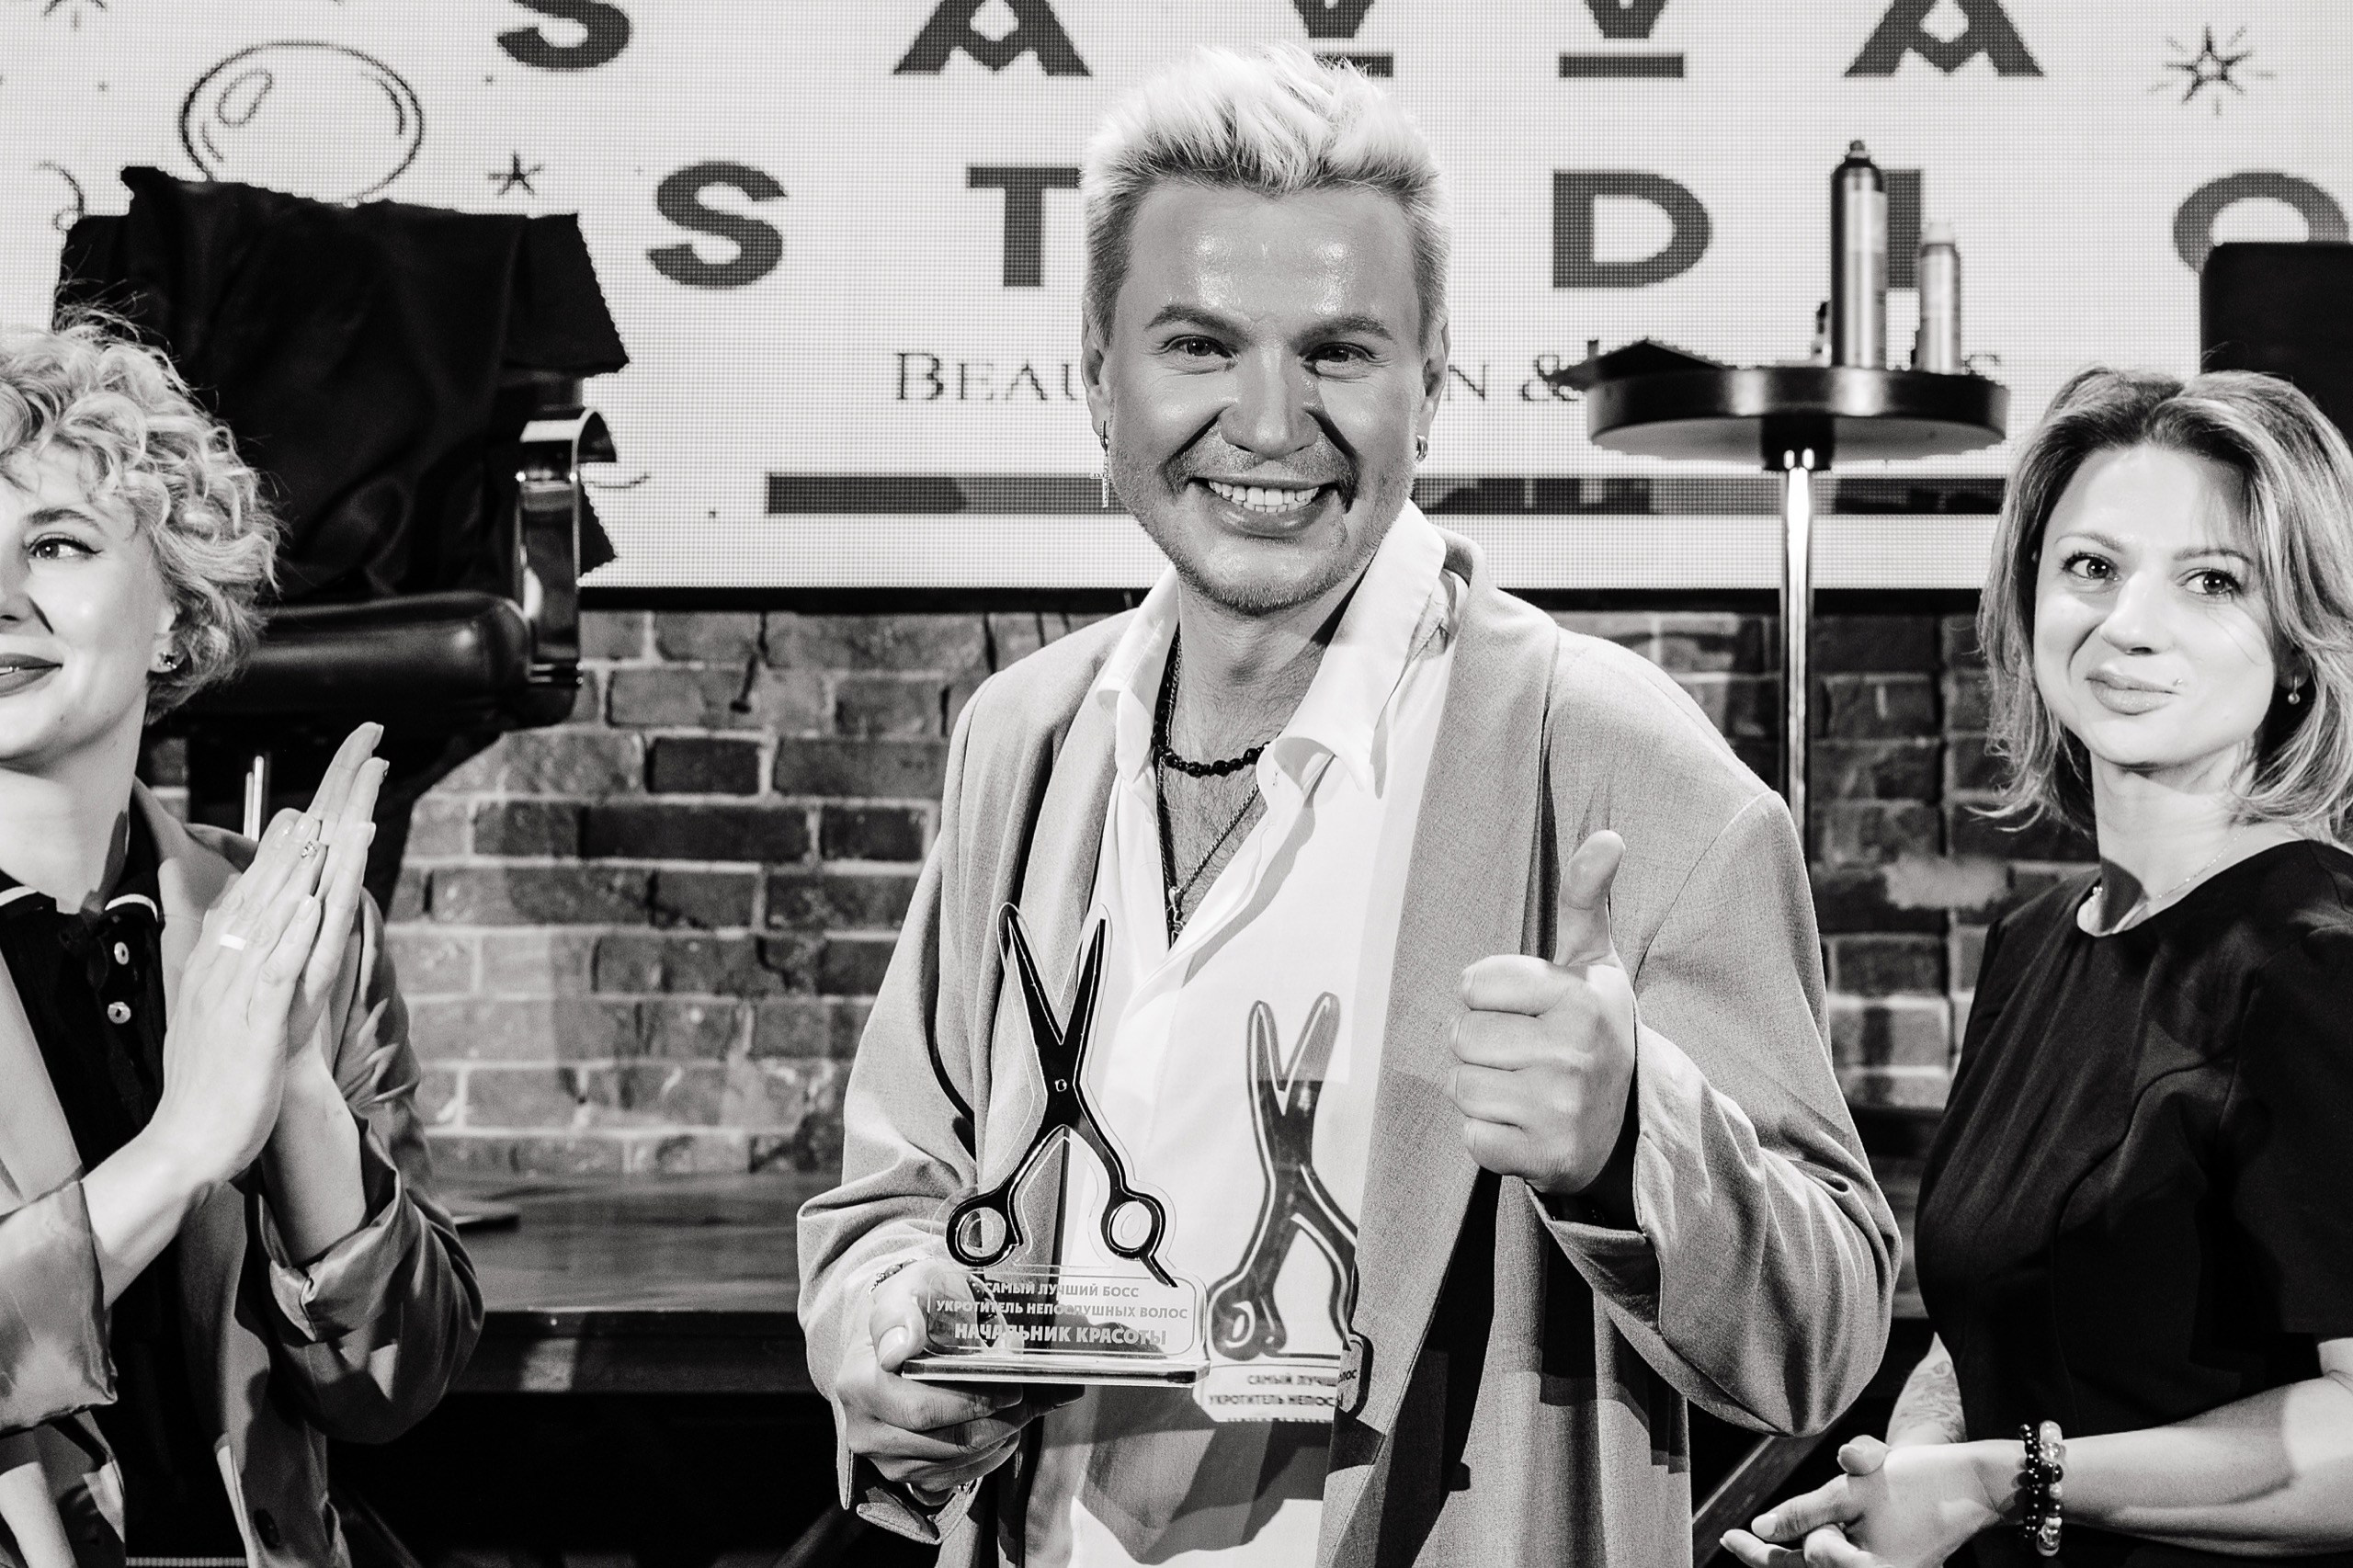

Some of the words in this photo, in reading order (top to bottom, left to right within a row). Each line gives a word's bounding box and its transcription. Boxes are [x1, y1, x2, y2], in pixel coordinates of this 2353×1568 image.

[647, 162, 2349, 288] STDIO
[984, 1281, 1035, 1295] САМЫЙ
[1037, 1283, 1098, 1297] ЛУЧШИЙ
[1103, 1287, 1140, 1298] БОСС
[936, 1300, 1024, 1314] УКРОТИТЕЛЬ
[1026, 1302, 1136, 1318] НЕПОСЛУШНЫХ
[1140, 1306, 1188, 1320] ВОЛОС
[1075, 1326, 1166, 1346] КРАСОТЫ
